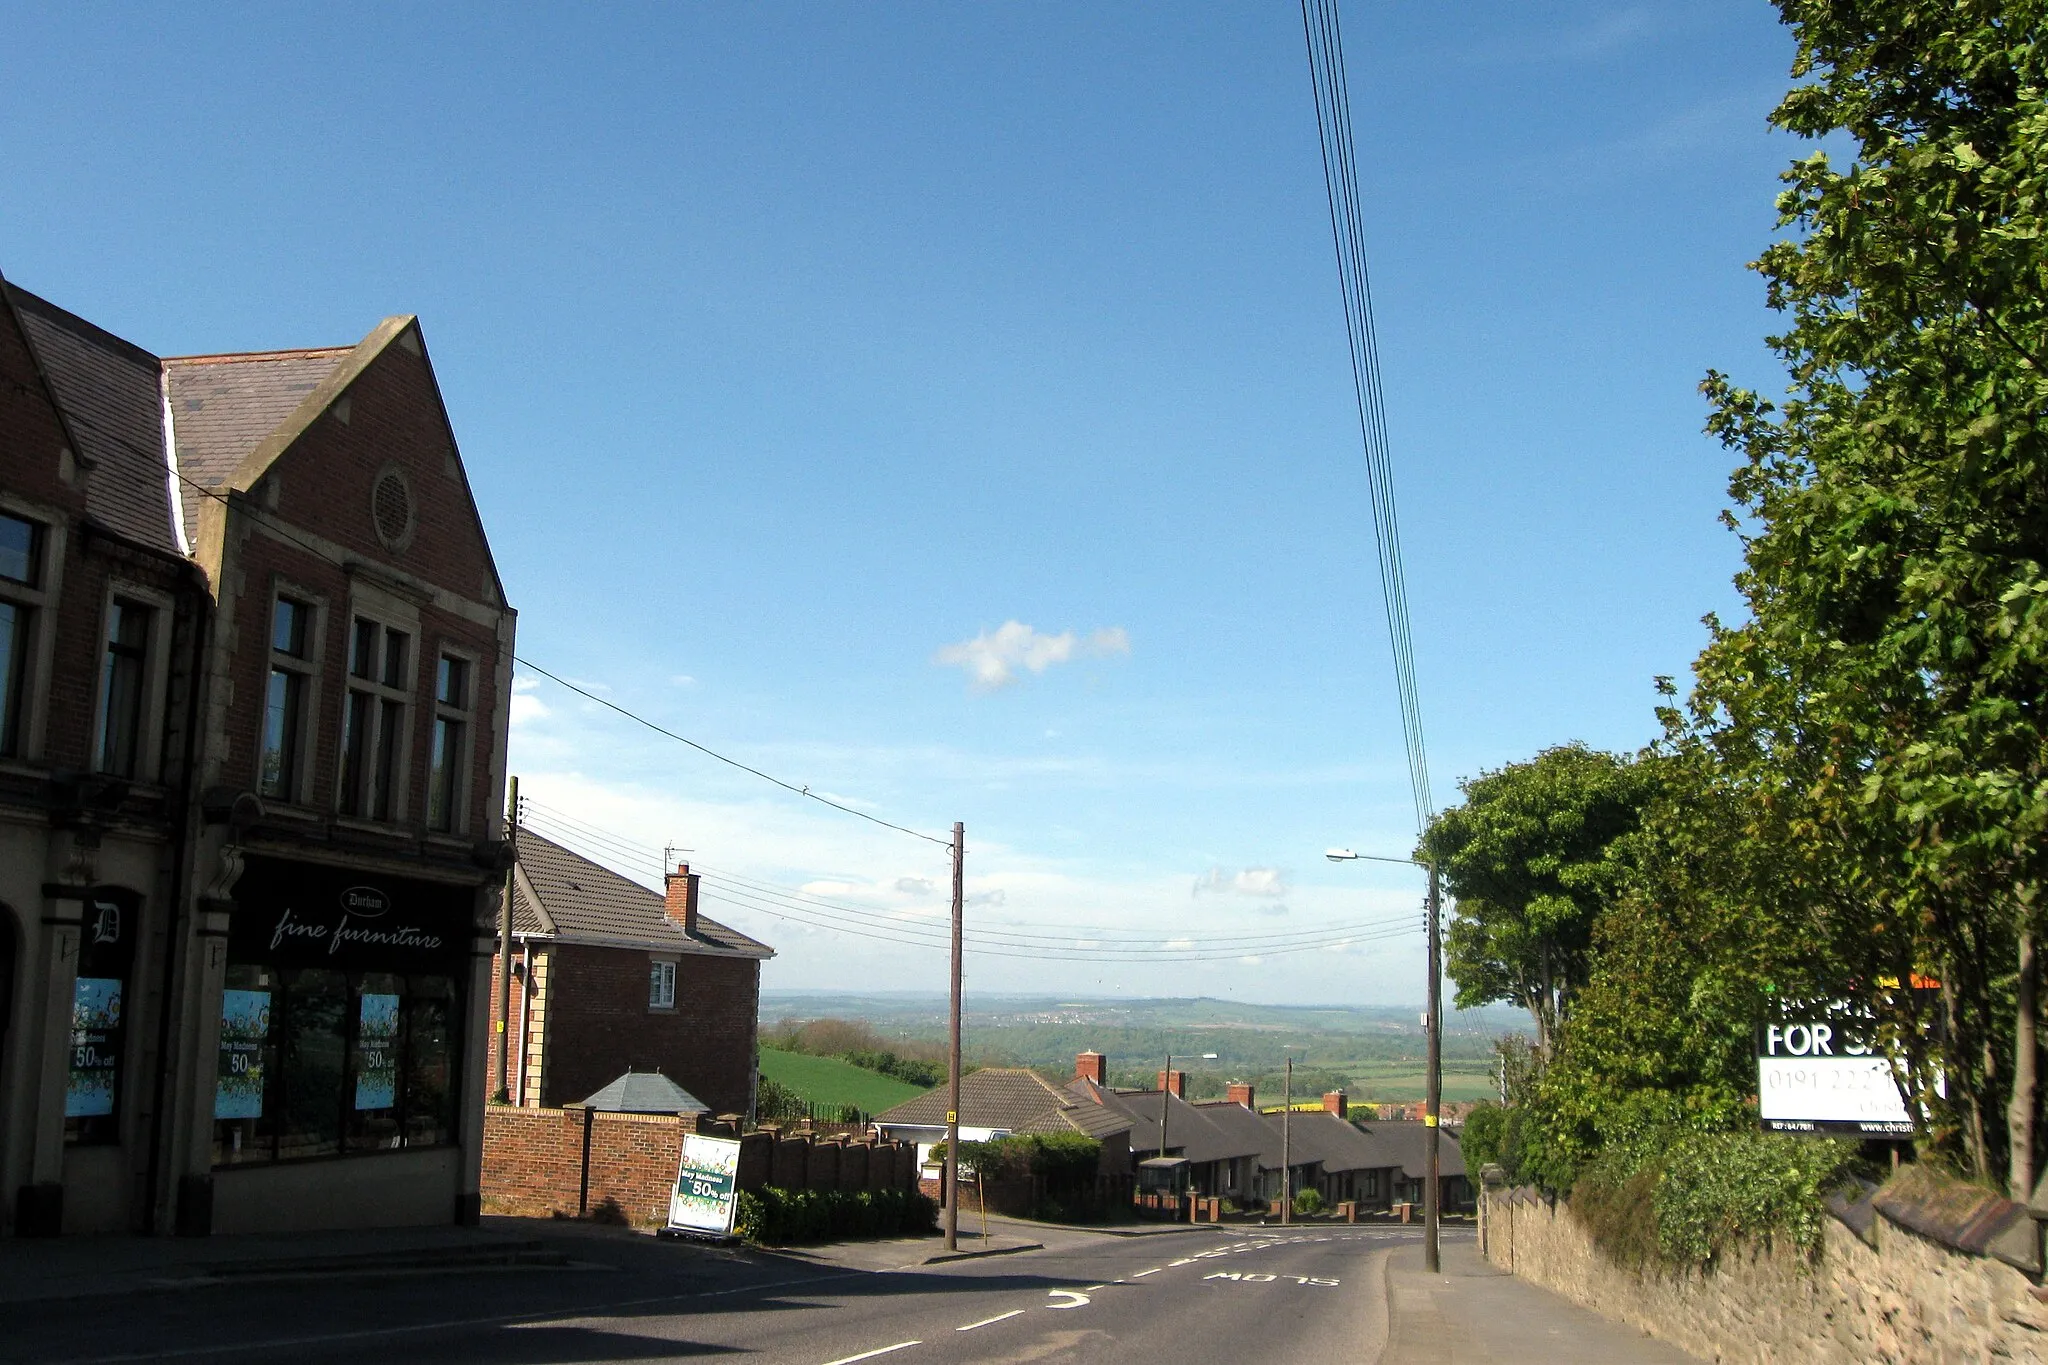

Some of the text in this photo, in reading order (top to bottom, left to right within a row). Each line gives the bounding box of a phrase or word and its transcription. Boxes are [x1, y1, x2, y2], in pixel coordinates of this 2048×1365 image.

[348, 893, 383, 909] Durham
[93, 900, 121, 944] D
[270, 907, 443, 956] fine furniture
[1768, 1023, 1833, 1056] FOR
[1768, 1069, 1818, 1090] 0191
[1831, 1069, 1872, 1090] 222
[1860, 1122, 1915, 1133] www.christi
[681, 1169, 723, 1184] May Madness
[692, 1180, 731, 1201] 50% off
